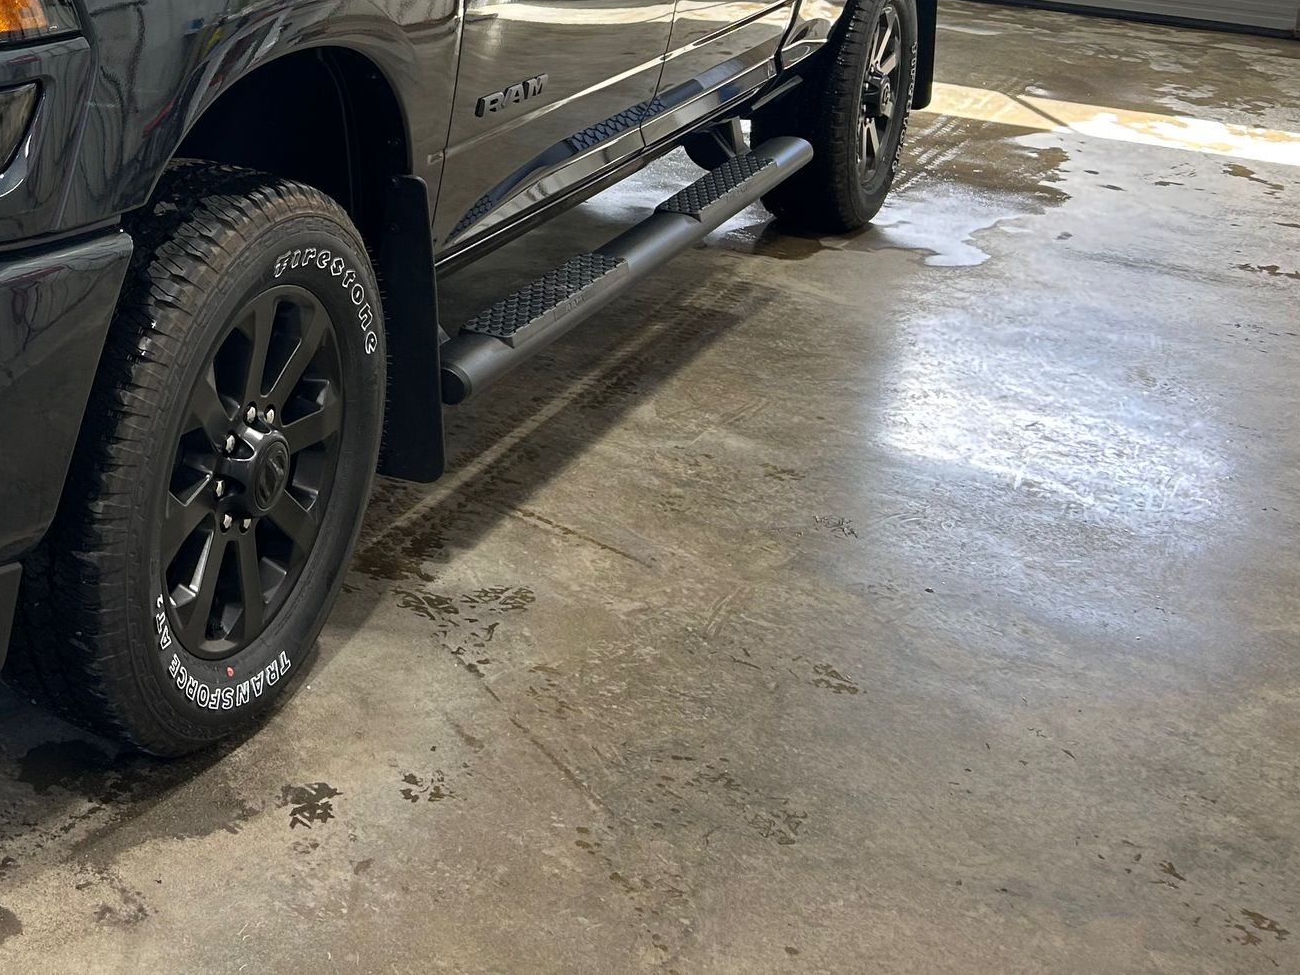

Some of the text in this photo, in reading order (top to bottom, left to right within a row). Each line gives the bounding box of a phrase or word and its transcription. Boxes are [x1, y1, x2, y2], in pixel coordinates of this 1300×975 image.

[474, 73, 549, 117] RAM
[274, 247, 378, 355] Firestone
[168, 650, 292, 710] TRANSFORCE
